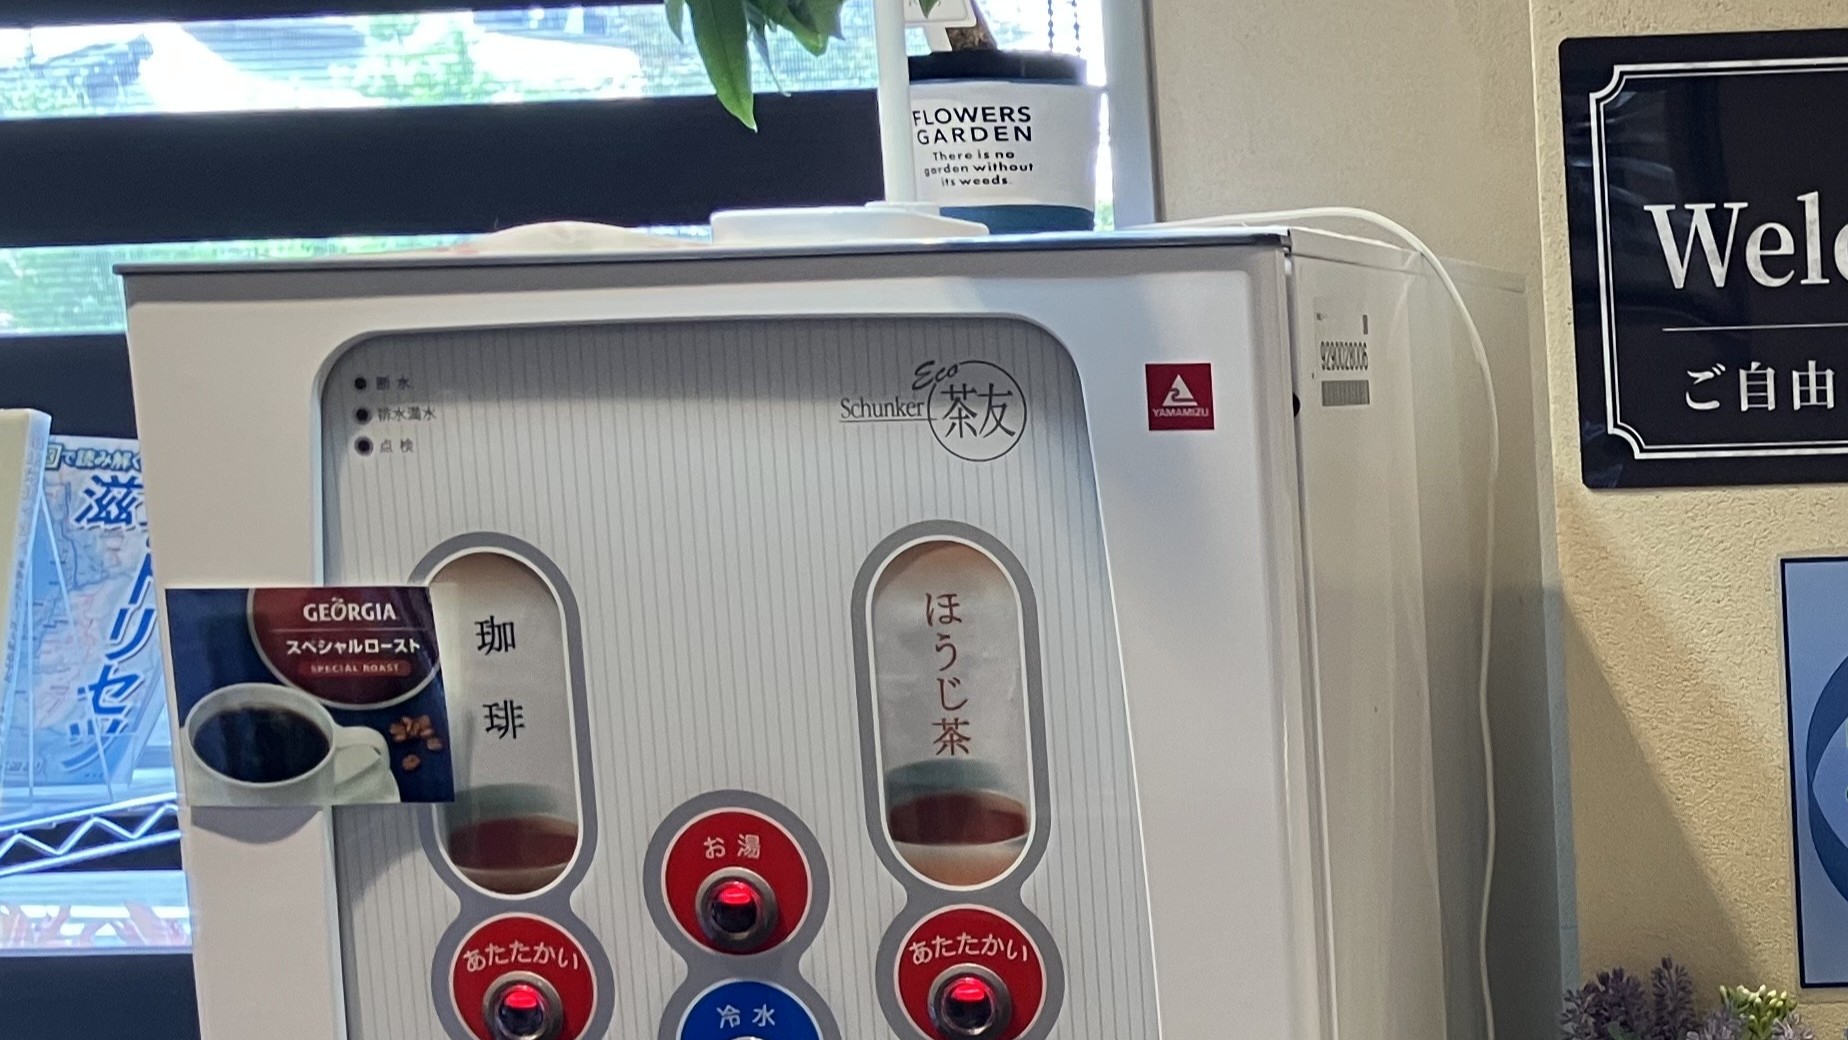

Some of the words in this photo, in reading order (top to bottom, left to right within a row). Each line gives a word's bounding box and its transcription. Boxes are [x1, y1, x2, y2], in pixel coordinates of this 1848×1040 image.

[912, 106, 1031, 126] FLOWERS
[917, 126, 1031, 145] GARDEN
[933, 151, 972, 161] There
[977, 149, 990, 160] is
[995, 151, 1015, 159] no
[924, 163, 969, 177] garden
[973, 161, 1034, 172] without
[941, 177, 956, 186] its
[911, 360, 959, 391] Eco
[840, 396, 925, 419] Schunker
[940, 382, 1016, 439] 茶友
[1152, 407, 1209, 417] YAMAMIZU
[74, 475, 148, 527] 滋
[286, 637, 420, 655] スペシャルロースト
[310, 664, 359, 673] SPECIAL
[363, 663, 399, 672] ROAST
[474, 615, 525, 740] 珈琲
[925, 592, 972, 756] ほうじ茶
[703, 834, 761, 859] お湯
[463, 940, 579, 972] あたたかい
[908, 932, 1028, 965] あたたかい
[716, 1003, 776, 1028] 冷水
